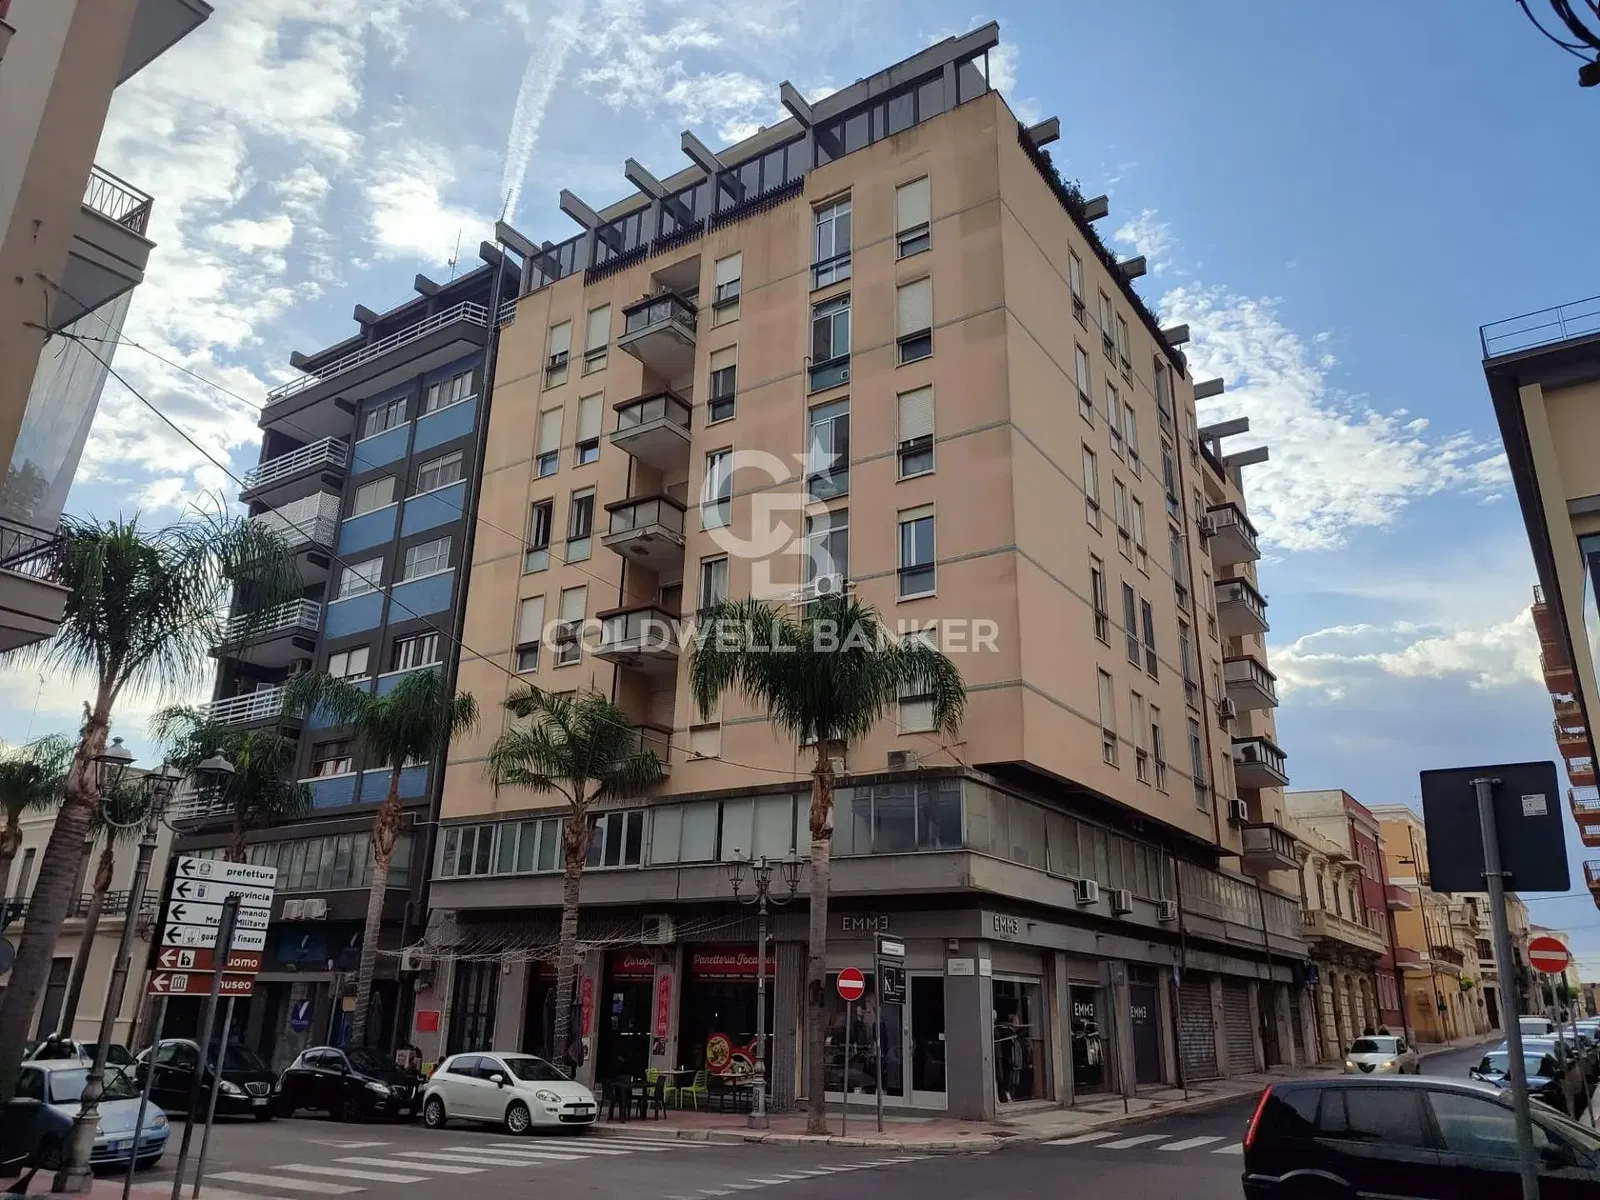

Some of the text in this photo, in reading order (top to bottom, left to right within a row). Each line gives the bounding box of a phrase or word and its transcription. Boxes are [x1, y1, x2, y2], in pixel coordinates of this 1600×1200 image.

[226, 868, 274, 880] prefettura
[229, 890, 270, 901] provincia
[237, 934, 262, 943] finanza
[227, 958, 258, 968] uomo
